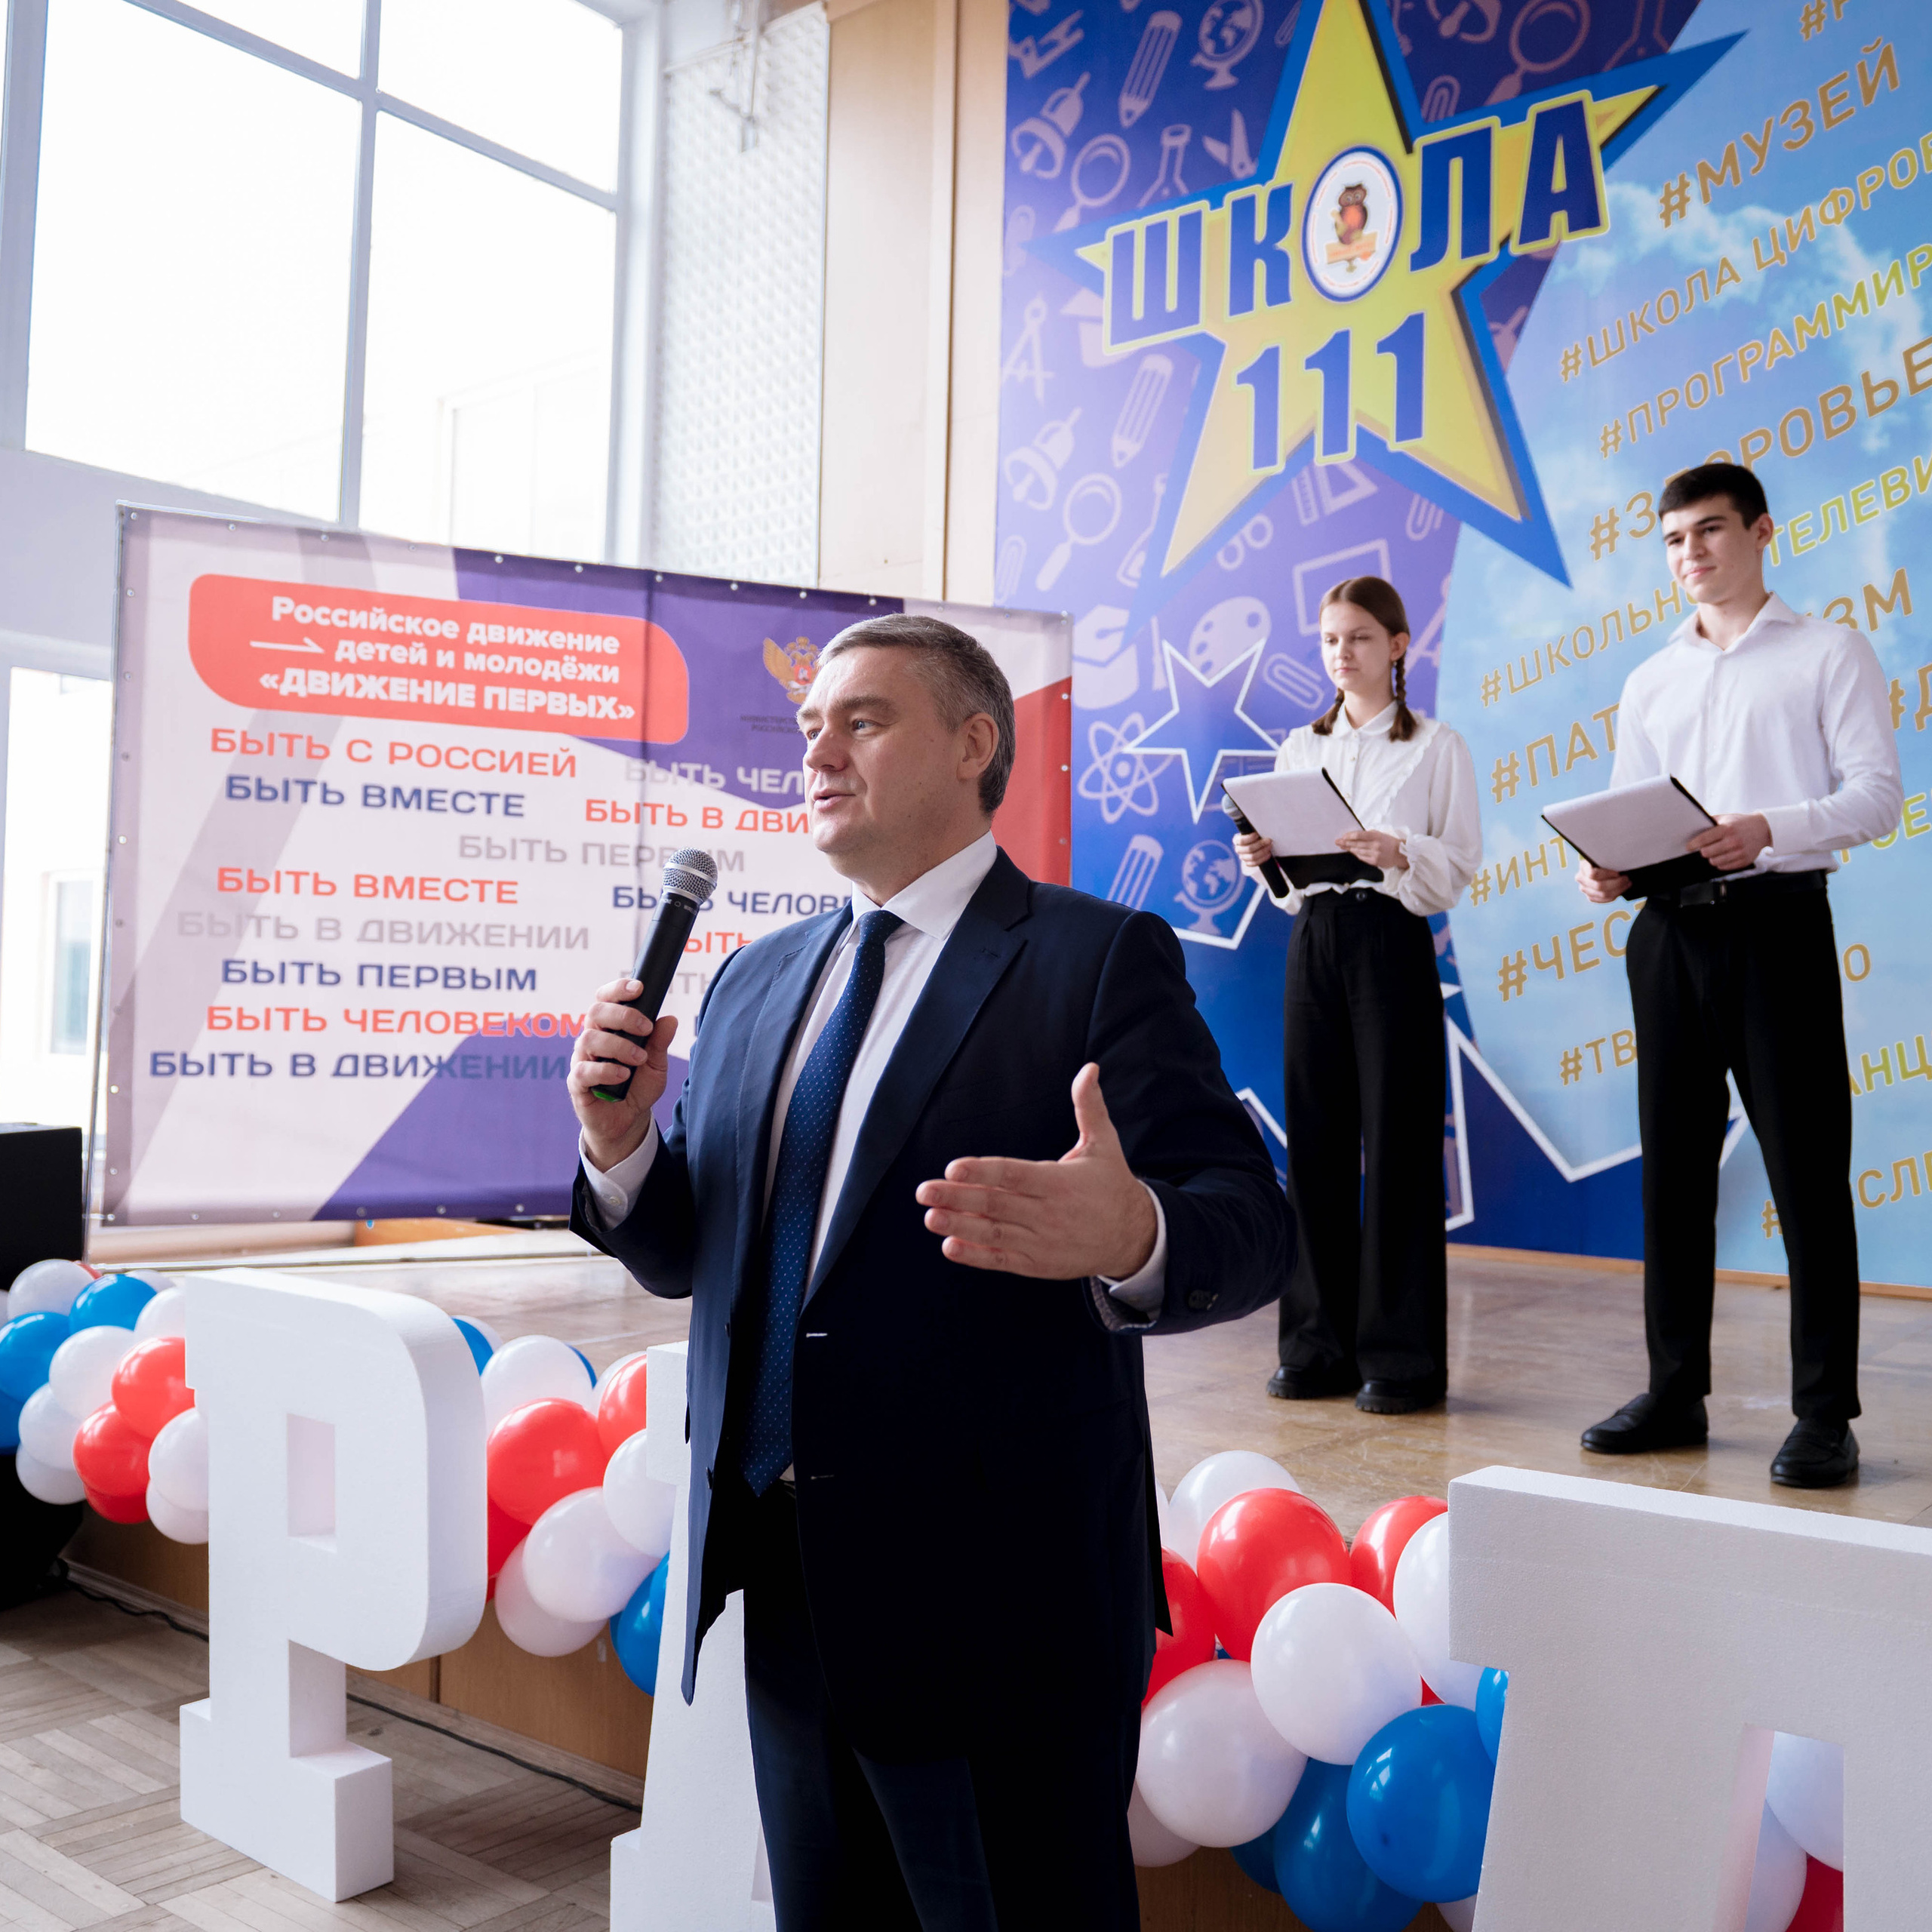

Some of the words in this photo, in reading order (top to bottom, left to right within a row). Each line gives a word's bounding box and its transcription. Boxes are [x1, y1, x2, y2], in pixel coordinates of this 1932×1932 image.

[1660, 36, 1900, 228] #МУЗЕЙ
[1106, 95, 1604, 349] ШКОЛА
[1561, 257, 1742, 383] #ШКОЛА
[1236, 312, 1425, 471] 111
[272, 596, 458, 638] Российское
[467, 621, 620, 655] движение
[1480, 579, 1700, 708] #ШКОЛЬН
[335, 639, 428, 666] детей
[436, 648, 454, 668] и
[463, 651, 620, 684] молодёжи
[259, 668, 475, 709] «ДВИЖЕНИЕ
[484, 686, 635, 721] ПЕРВЫХ»
[211, 728, 331, 762] БЫТЬ
[346, 739, 373, 763] С
[389, 741, 577, 779] РОССИЕЙ
[625, 758, 726, 789] БЫТЬ
[226, 775, 345, 806] БЫТЬ
[362, 785, 525, 818] ВМЕСТЕ
[586, 799, 688, 827] БЫТЬ
[702, 807, 724, 829] В
[459, 835, 567, 863] БЫТЬ
[1470, 835, 1586, 907] #ИНТ
[217, 866, 337, 896] БЫТЬ
[353, 874, 518, 904] ВМЕСТЕ
[728, 889, 851, 915] ЧЕЛОВ
[177, 911, 299, 940] БЫТЬ
[315, 918, 341, 941] В
[355, 920, 590, 950] ДВИЖЕНИИ
[1498, 900, 1647, 1002] #ЧЕС
[223, 959, 341, 985] БЫТЬ
[358, 964, 537, 990] ПЕРВЫМ
[207, 1006, 327, 1032] БЫТЬ
[150, 1051, 273, 1077] БЫТЬ
[291, 1053, 315, 1077] В
[332, 1053, 567, 1079] ДВИЖЕНИИ
